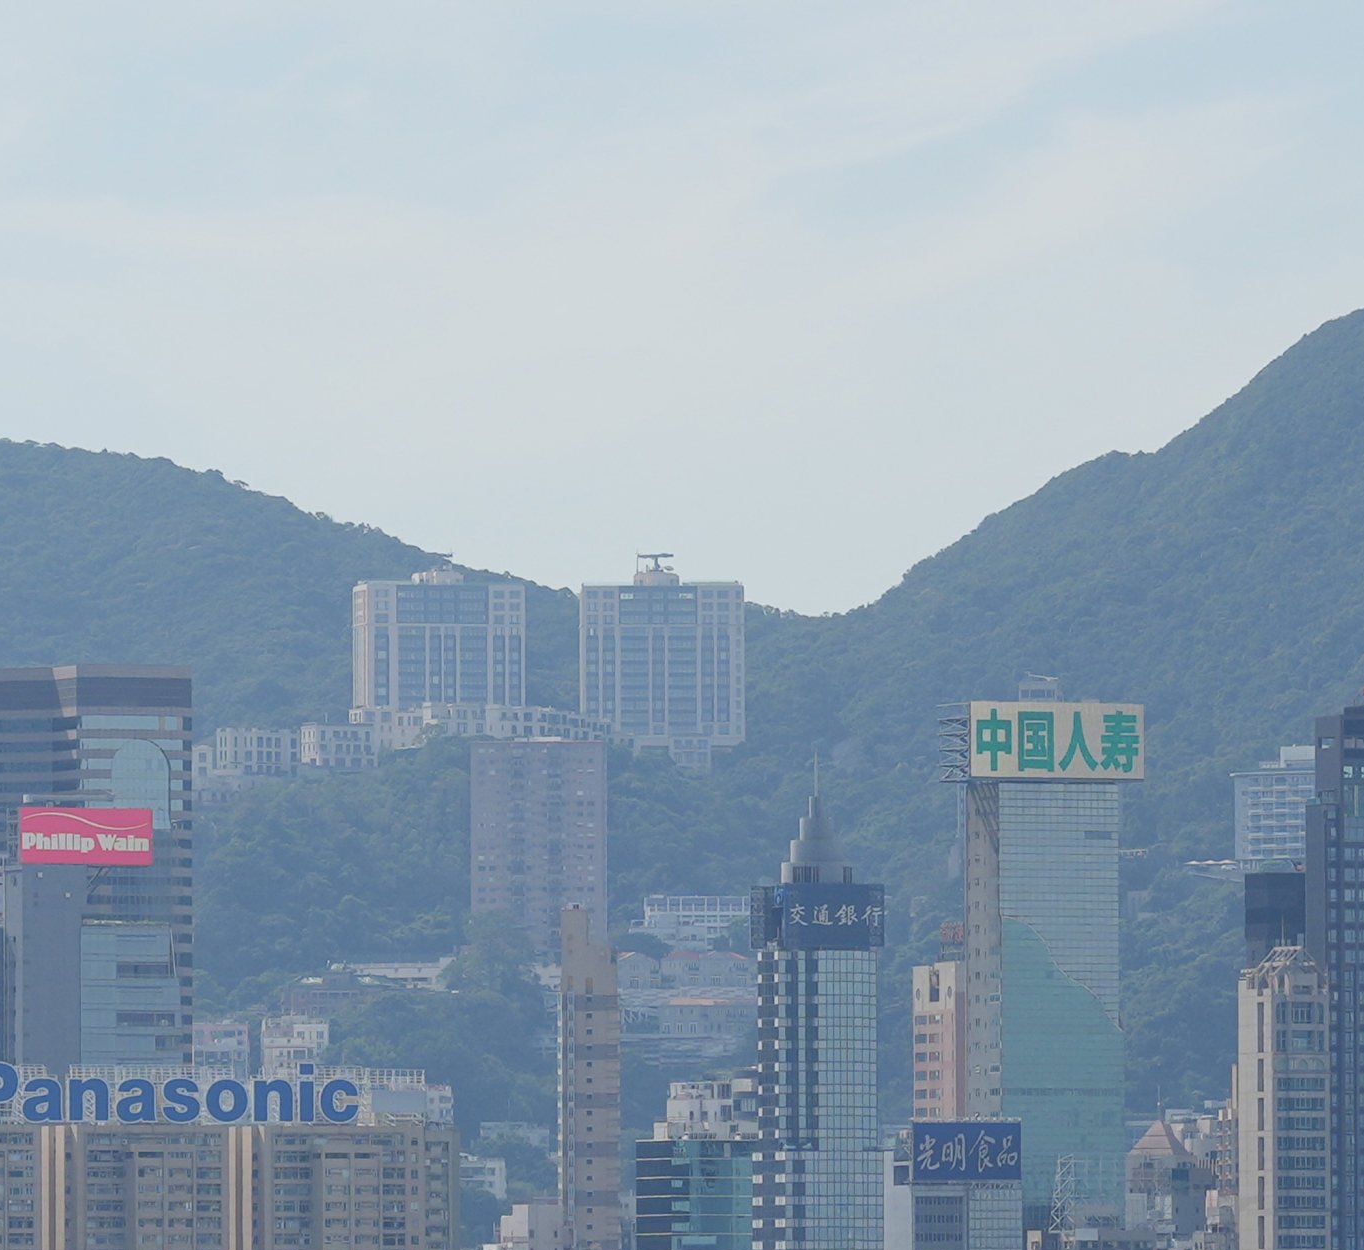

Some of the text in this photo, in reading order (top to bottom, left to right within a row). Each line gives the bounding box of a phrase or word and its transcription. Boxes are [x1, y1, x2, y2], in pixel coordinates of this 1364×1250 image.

[976, 708, 1140, 773] 中国人寿
[21, 832, 150, 853] Phillip Wain
[789, 904, 883, 926] 交通銀行
[917, 1130, 1018, 1172] 光明食品
